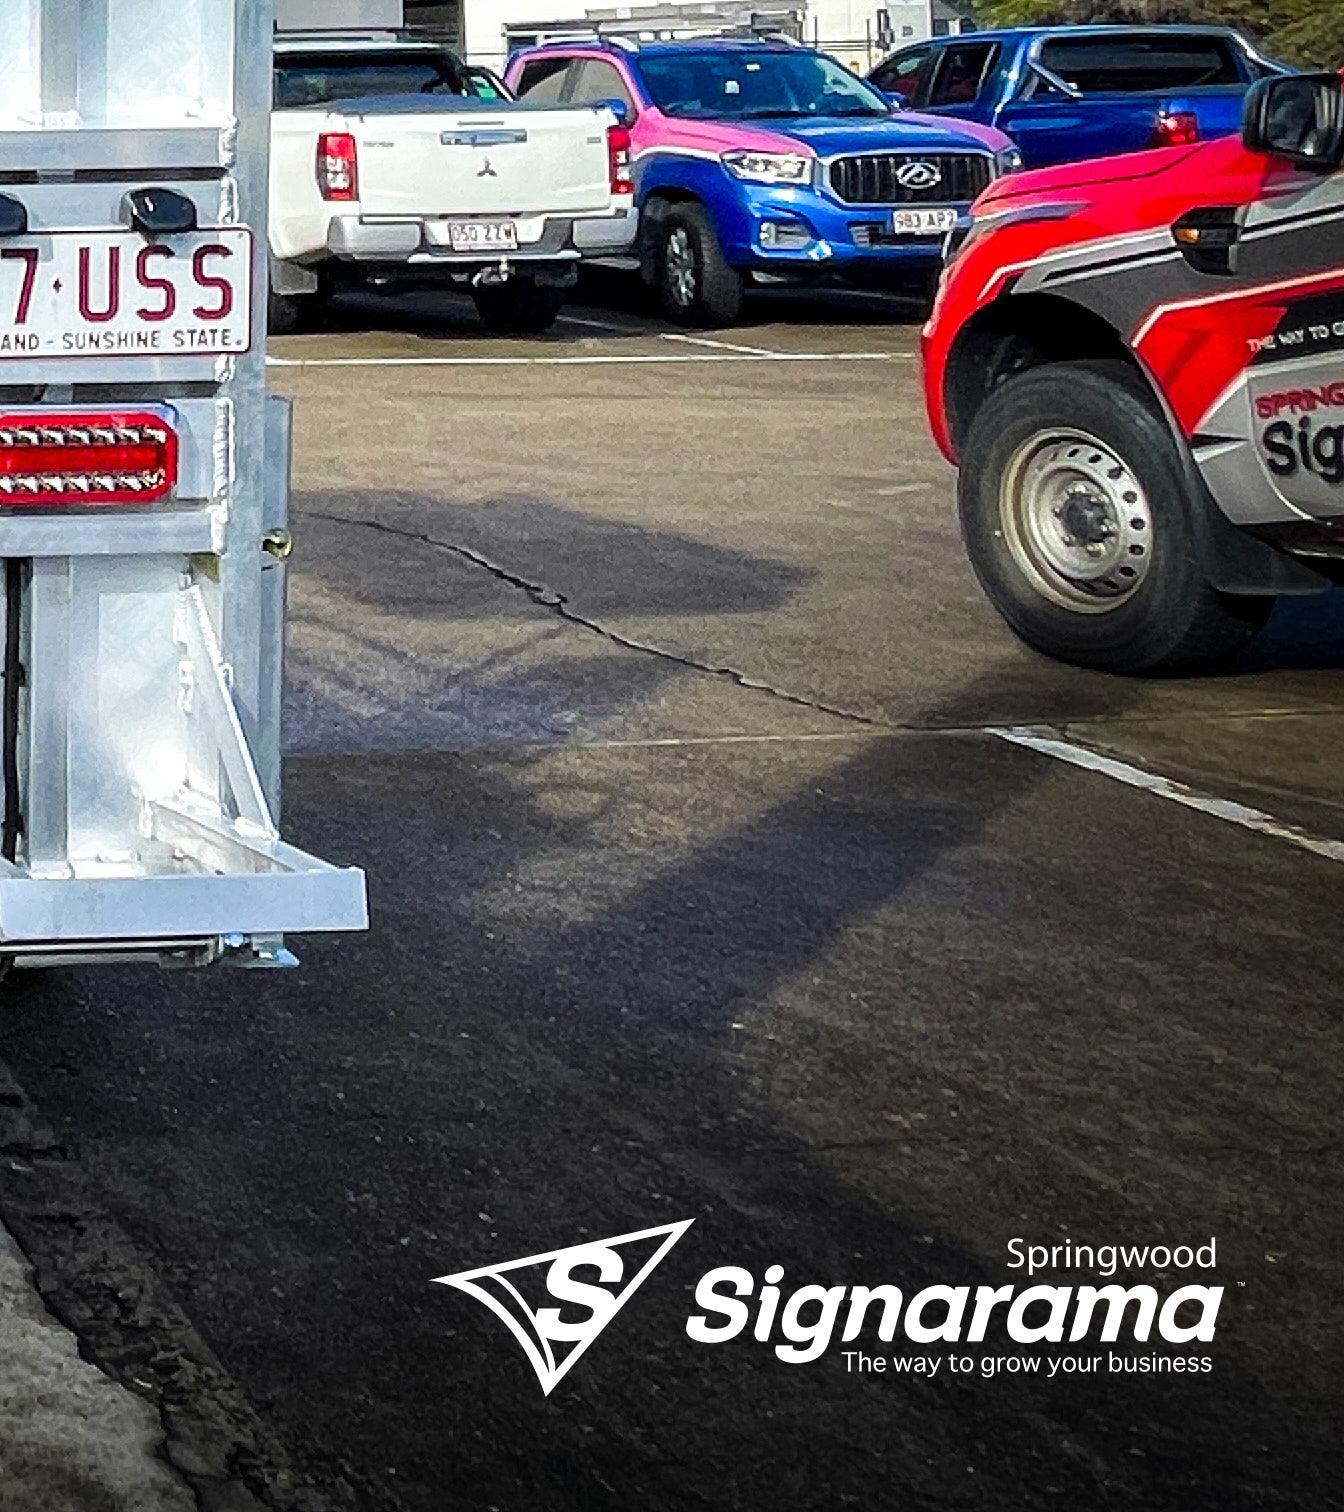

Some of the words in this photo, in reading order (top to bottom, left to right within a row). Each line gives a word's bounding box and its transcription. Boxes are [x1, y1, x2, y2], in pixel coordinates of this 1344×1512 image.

[78, 244, 234, 322] USS
[62, 331, 161, 350] SUNSHINE
[173, 329, 232, 347] STATE
[1264, 418, 1344, 483] Sig
